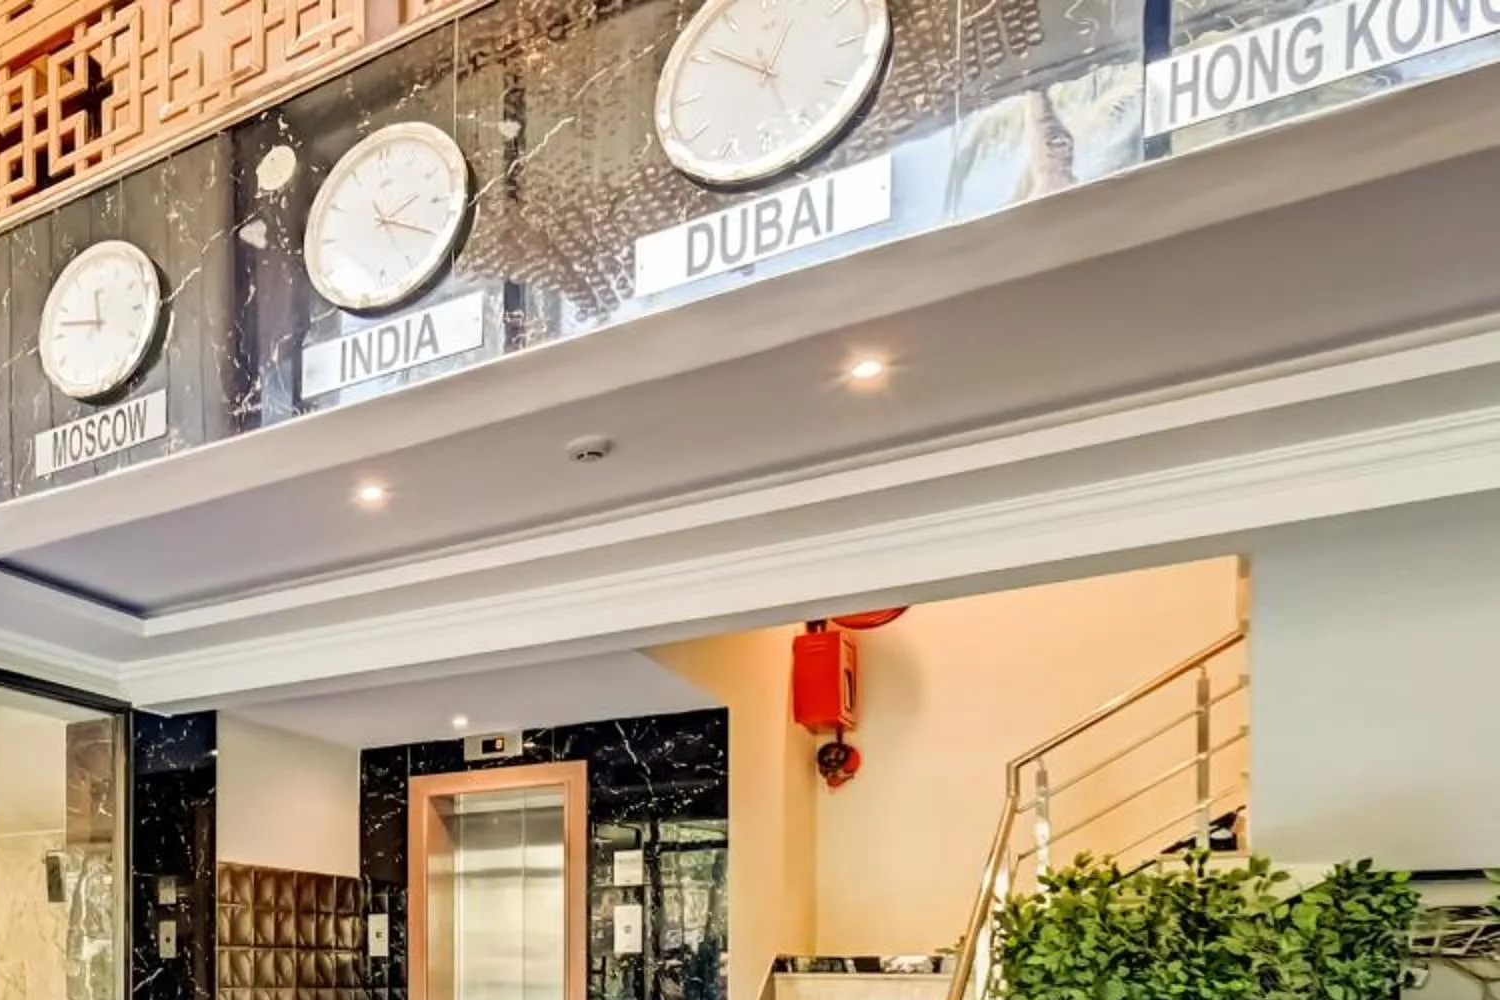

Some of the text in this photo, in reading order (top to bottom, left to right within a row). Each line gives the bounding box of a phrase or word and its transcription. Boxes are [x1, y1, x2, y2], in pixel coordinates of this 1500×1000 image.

[1168, 0, 1500, 123] HONG KON
[685, 177, 836, 277] DUBAI
[339, 312, 440, 383] INDIA
[52, 398, 149, 468] MOSCOW
